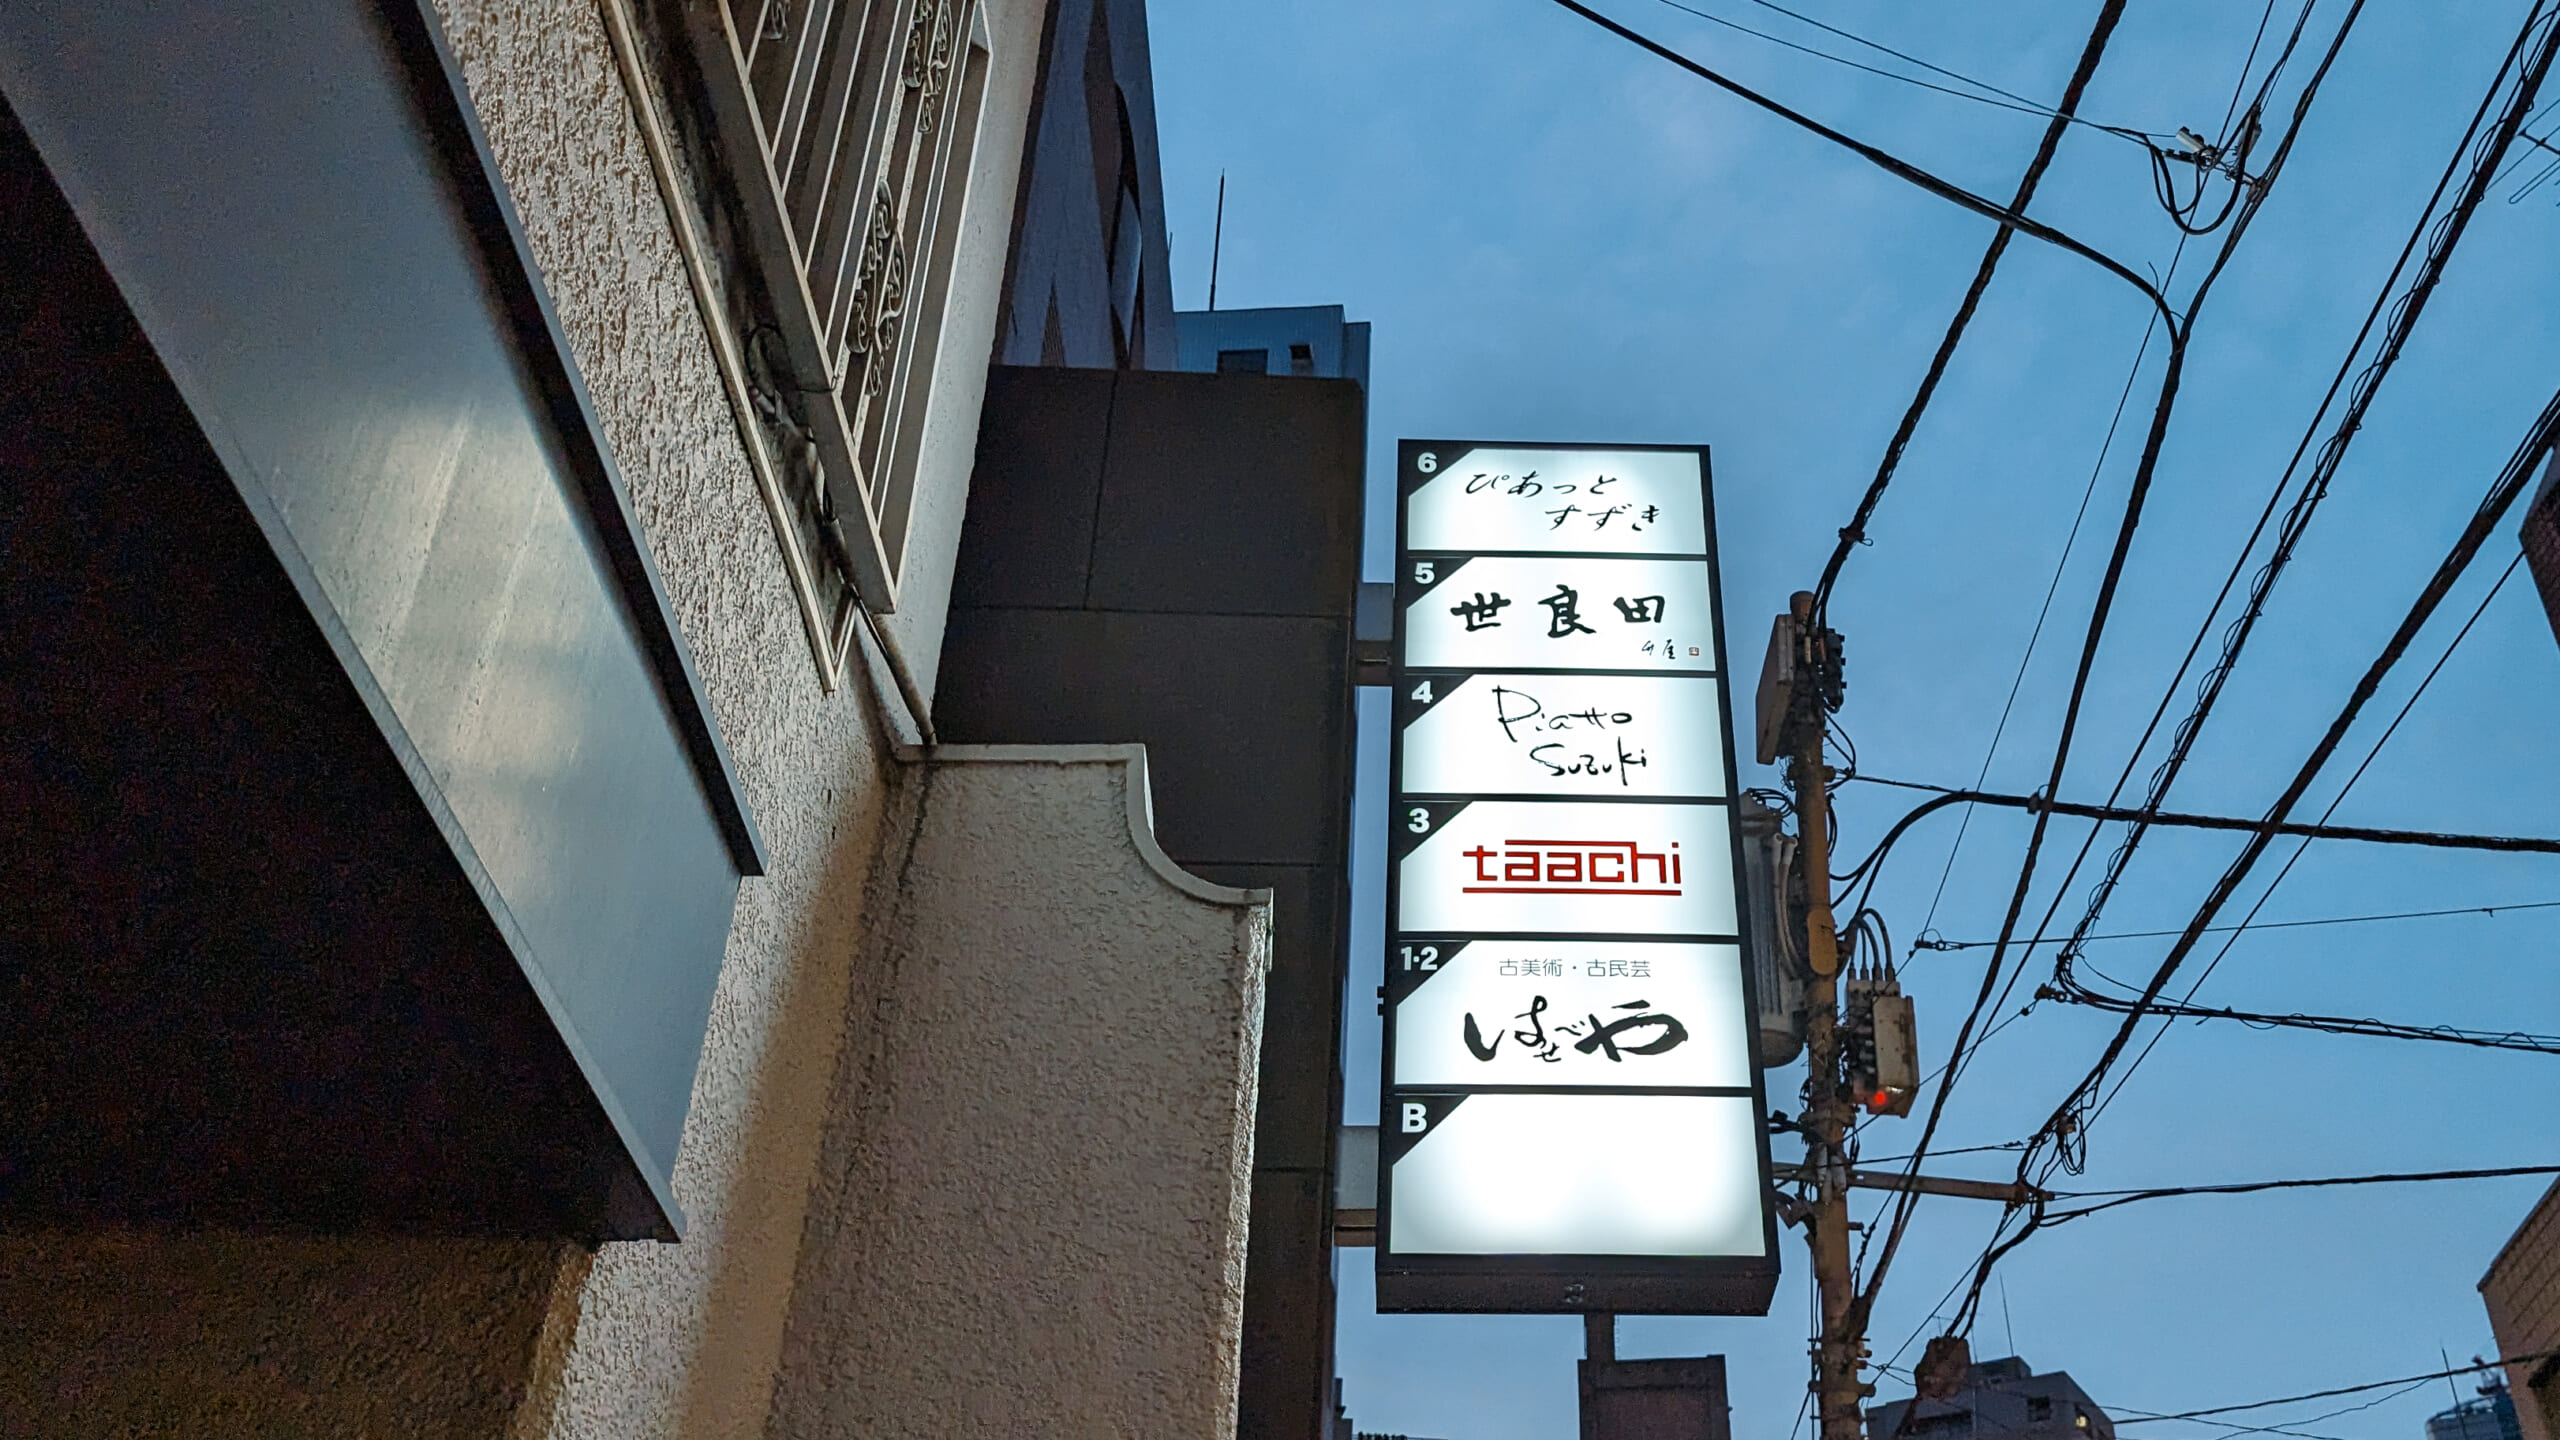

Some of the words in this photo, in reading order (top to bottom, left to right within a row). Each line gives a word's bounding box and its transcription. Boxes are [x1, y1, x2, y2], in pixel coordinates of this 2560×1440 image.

[1417, 452, 1438, 474] 6
[1465, 470, 1617, 498] ぴあっと
[1545, 504, 1661, 532] すずき
[1414, 562, 1435, 585] 5
[1411, 680, 1433, 704] 4
[1491, 685, 1633, 743] Piatto
[1529, 736, 1648, 787] Suzuki
[1408, 807, 1431, 834] 3
[1462, 839, 1682, 885] taachi
[1401, 1103, 1428, 1134] B
